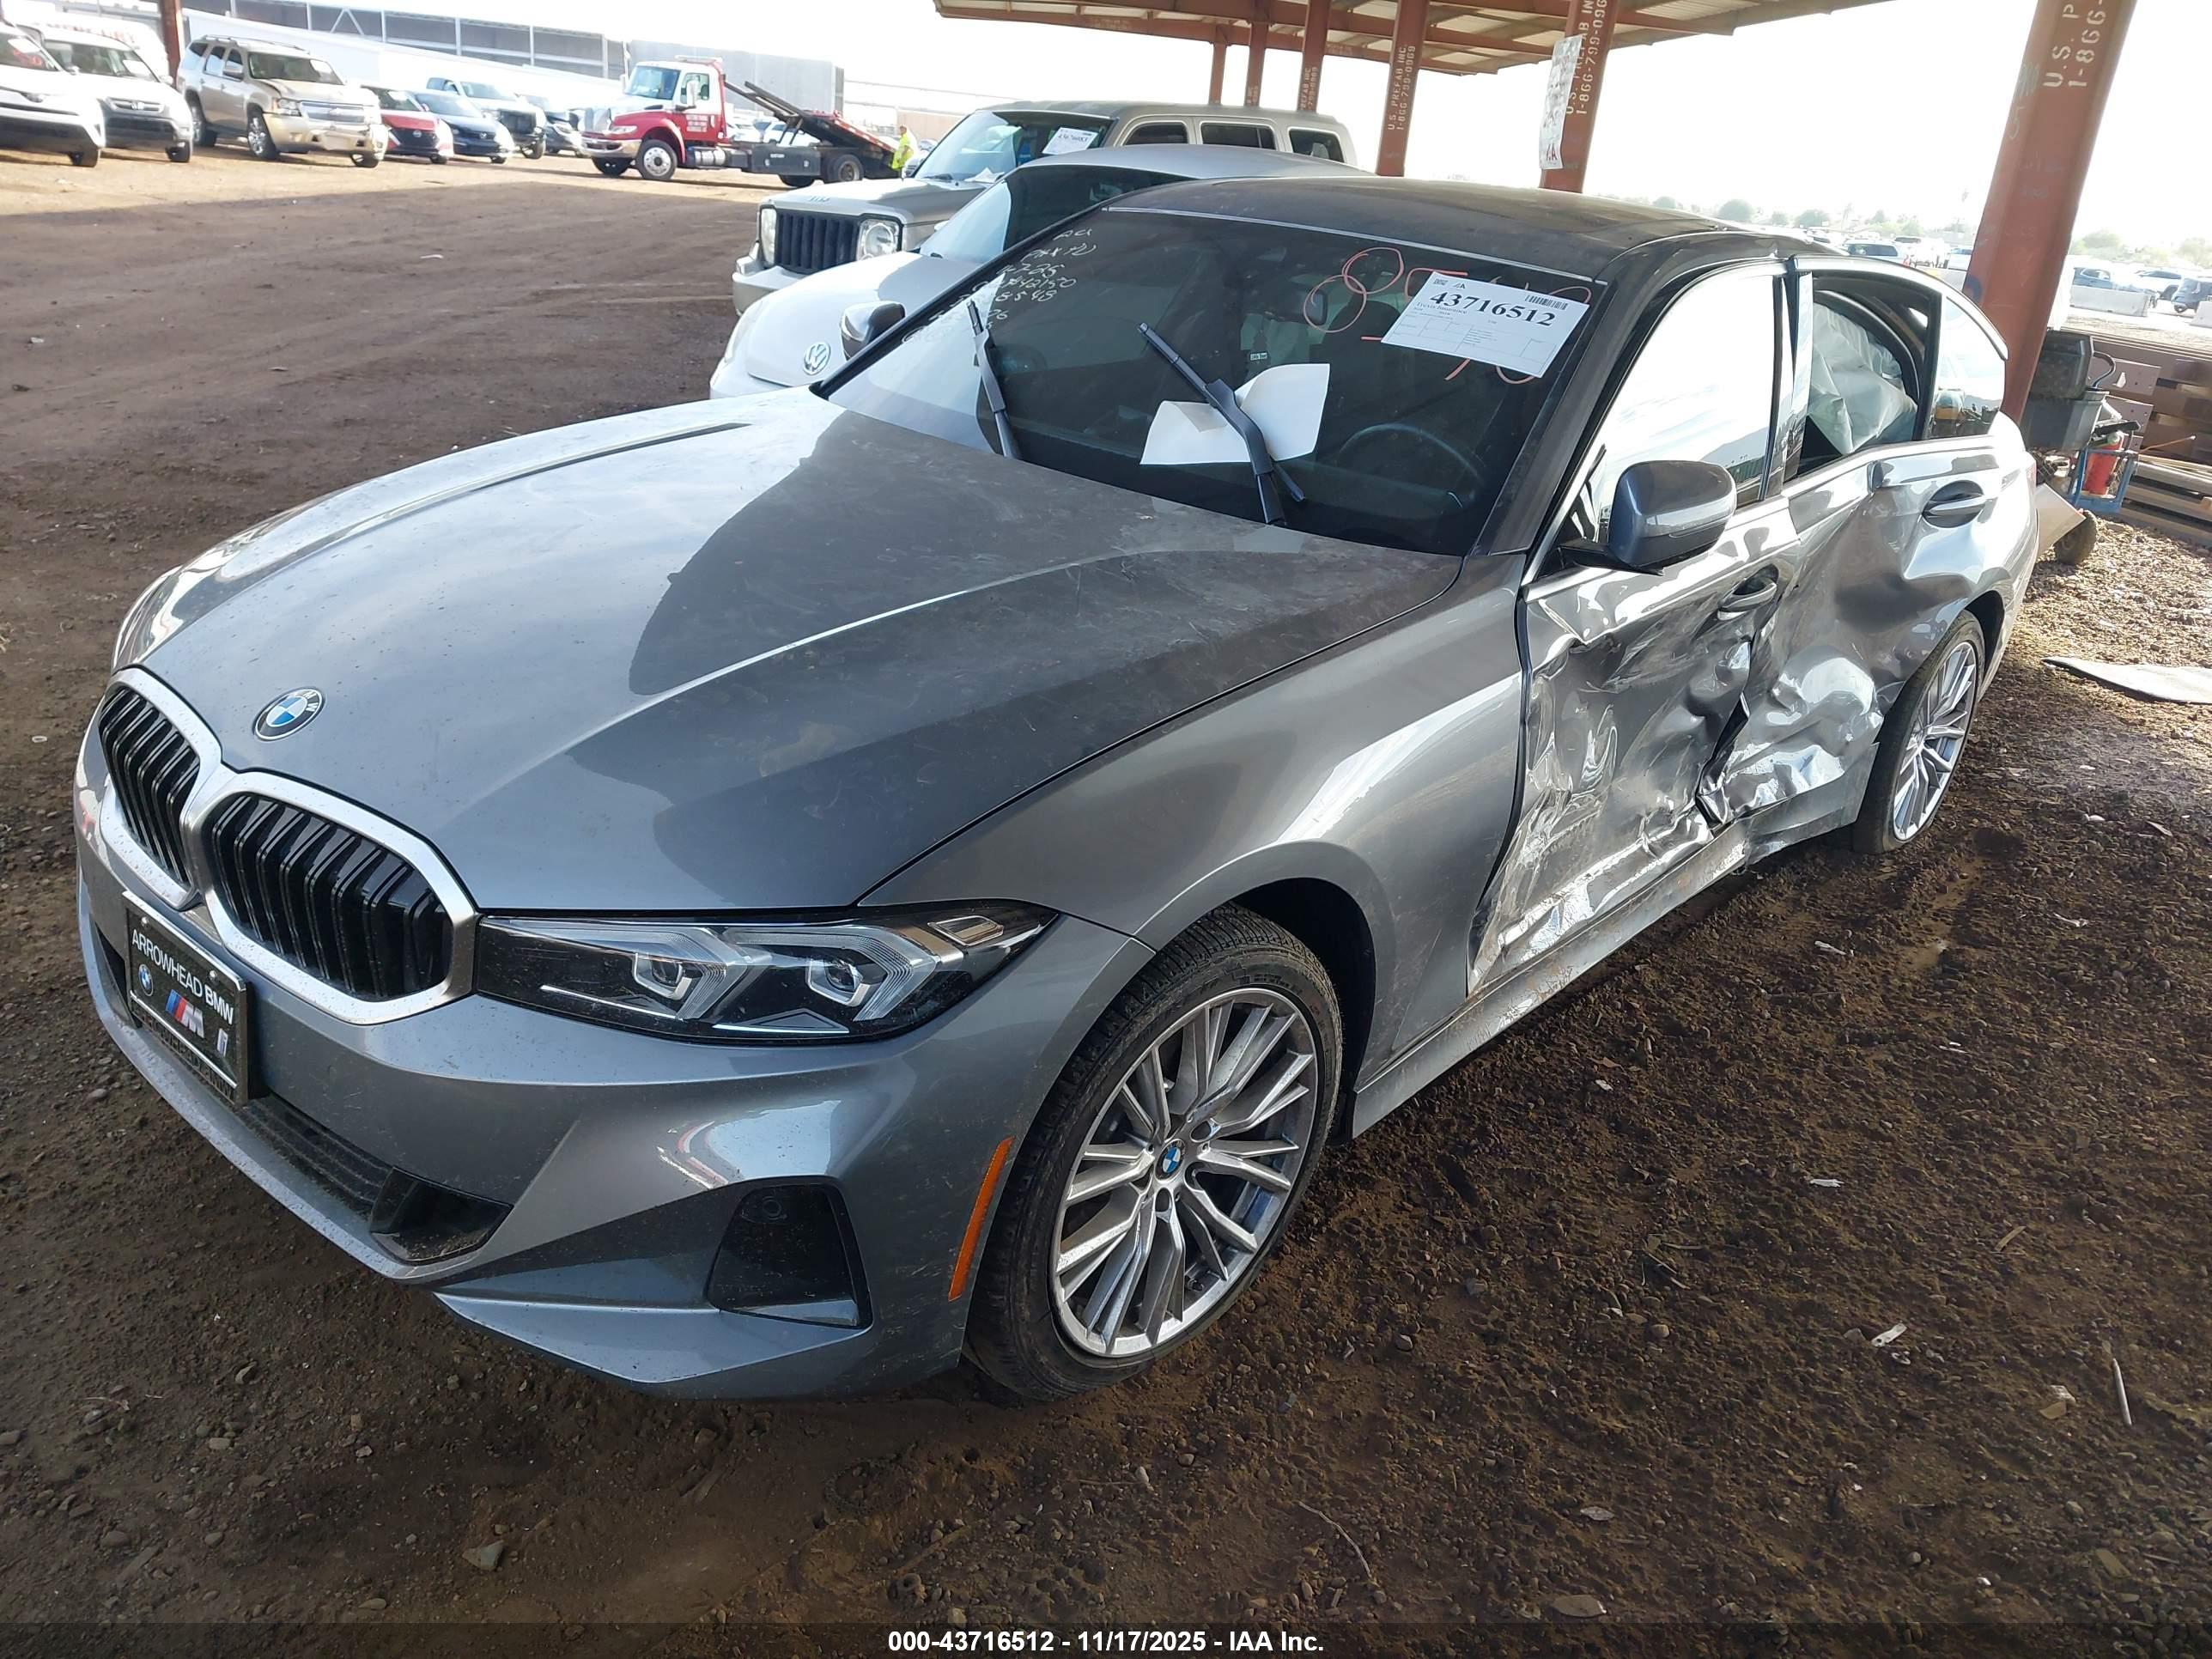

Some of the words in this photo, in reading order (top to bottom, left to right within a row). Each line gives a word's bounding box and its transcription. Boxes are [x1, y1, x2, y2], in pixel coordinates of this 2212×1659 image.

[2043, 38, 2075, 88] U.S.
[2062, 3, 2080, 19] P
[1391, 68, 1403, 107] PREFAB
[1430, 291, 1556, 327] 43716512
[131, 928, 203, 998] ARROWHEAD
[204, 985, 234, 1025] BMW
